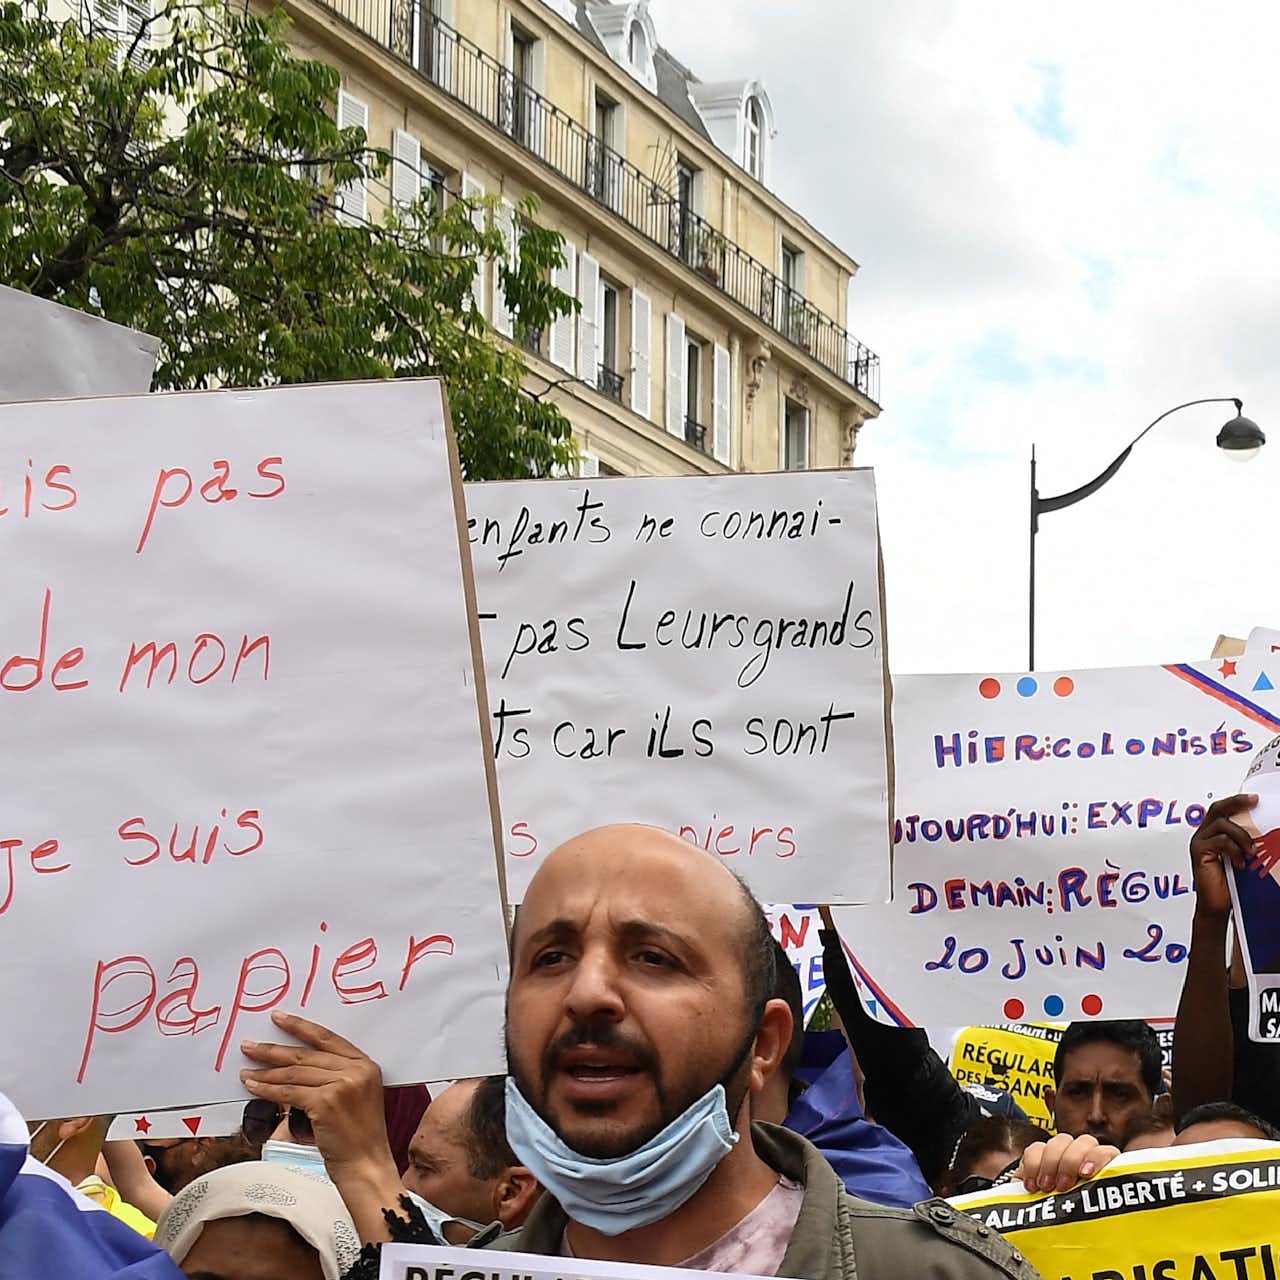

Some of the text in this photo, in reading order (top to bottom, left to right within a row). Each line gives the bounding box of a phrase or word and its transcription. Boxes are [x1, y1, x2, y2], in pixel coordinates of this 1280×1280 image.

[0, 456, 286, 554] is pas
[467, 489, 612, 573] enfants
[635, 515, 674, 543] ne
[0, 587, 271, 692] de mon
[501, 614, 591, 680] pas
[552, 720, 627, 760] car
[743, 702, 856, 756] sont
[117, 808, 265, 867] suis
[925, 935, 990, 974] 20
[76, 921, 456, 1086] papier
[1080, 1170, 1186, 1214] LIBERTÉ
